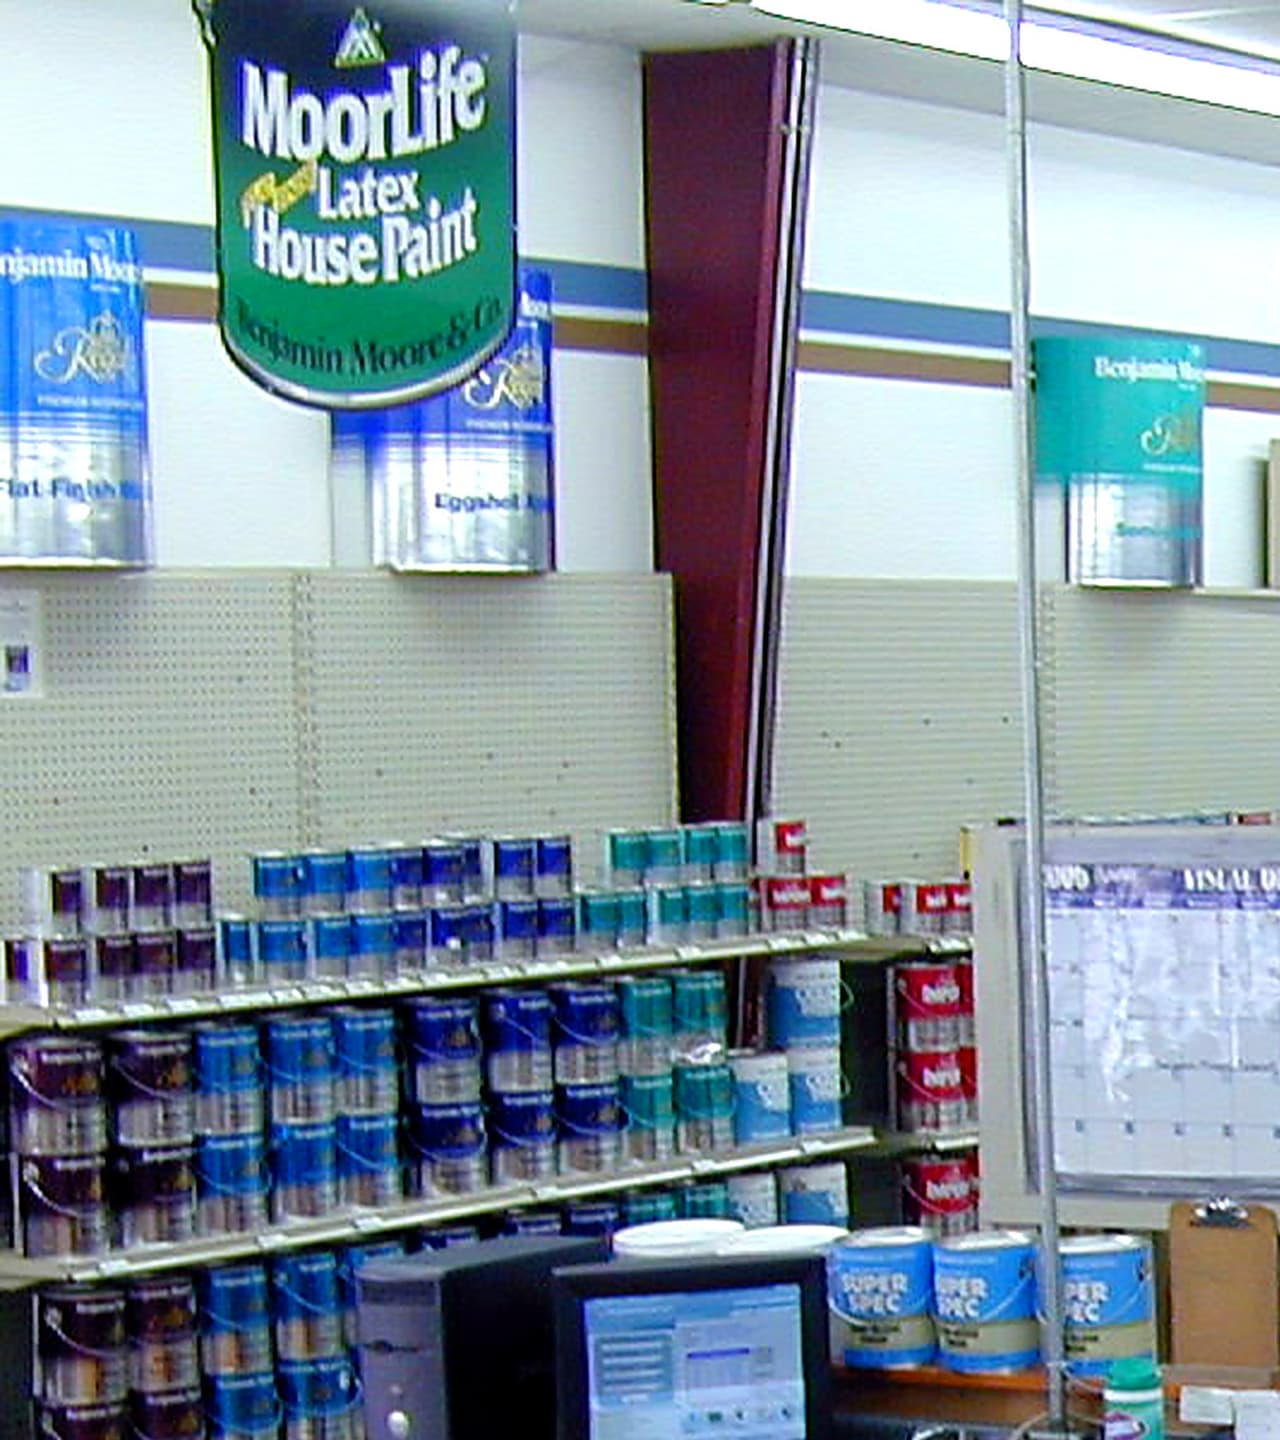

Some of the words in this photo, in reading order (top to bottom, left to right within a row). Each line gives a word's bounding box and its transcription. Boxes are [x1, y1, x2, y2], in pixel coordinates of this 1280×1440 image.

[243, 47, 487, 162] MoorLife
[318, 167, 419, 219] Latex
[254, 206, 379, 284] House
[381, 187, 477, 282] Paint
[1063, 1281, 1110, 1303] PER
